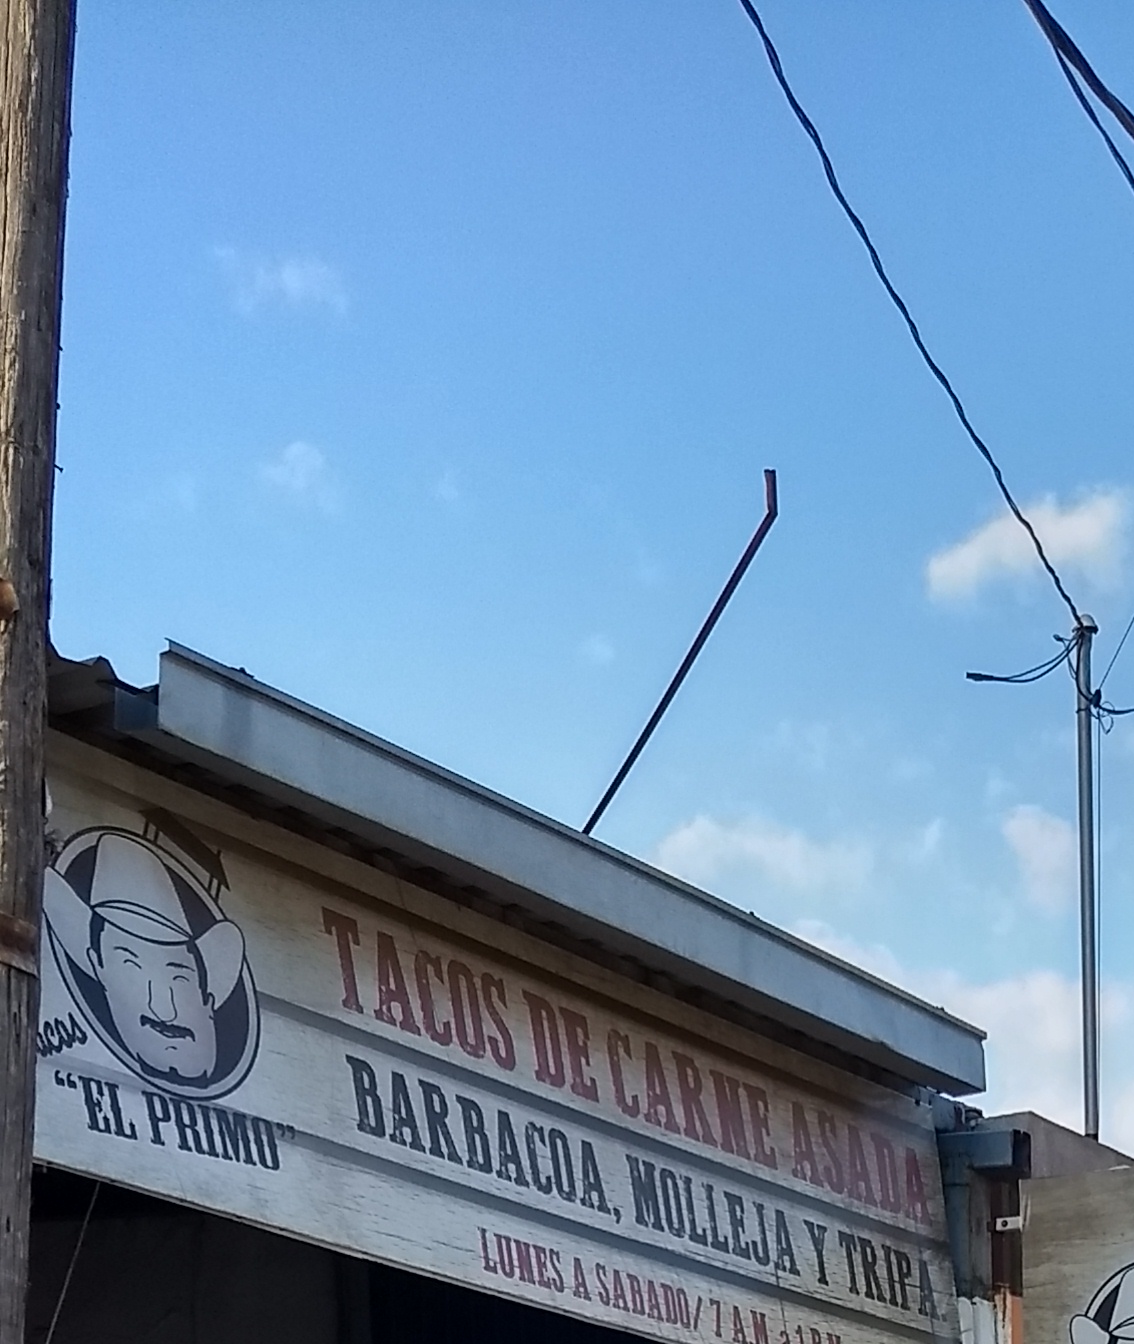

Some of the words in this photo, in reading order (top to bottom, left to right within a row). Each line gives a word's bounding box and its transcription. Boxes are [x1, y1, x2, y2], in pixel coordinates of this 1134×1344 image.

[54, 1069, 138, 1141] “EL
[141, 1089, 297, 1172] PRIMO”
[321, 906, 516, 1072] TACOS
[522, 988, 599, 1102] DE
[606, 1028, 778, 1171] CARNE
[790, 1099, 933, 1228] ASADA
[345, 1053, 622, 1225] BARBACOA,
[625, 1153, 801, 1278] MOLLEJA
[803, 1218, 829, 1287] Y
[838, 1229, 947, 1323] TRIPA.
[477, 1226, 565, 1294] LUNES
[572, 1256, 592, 1303] A
[709, 1297, 723, 1338] 7
